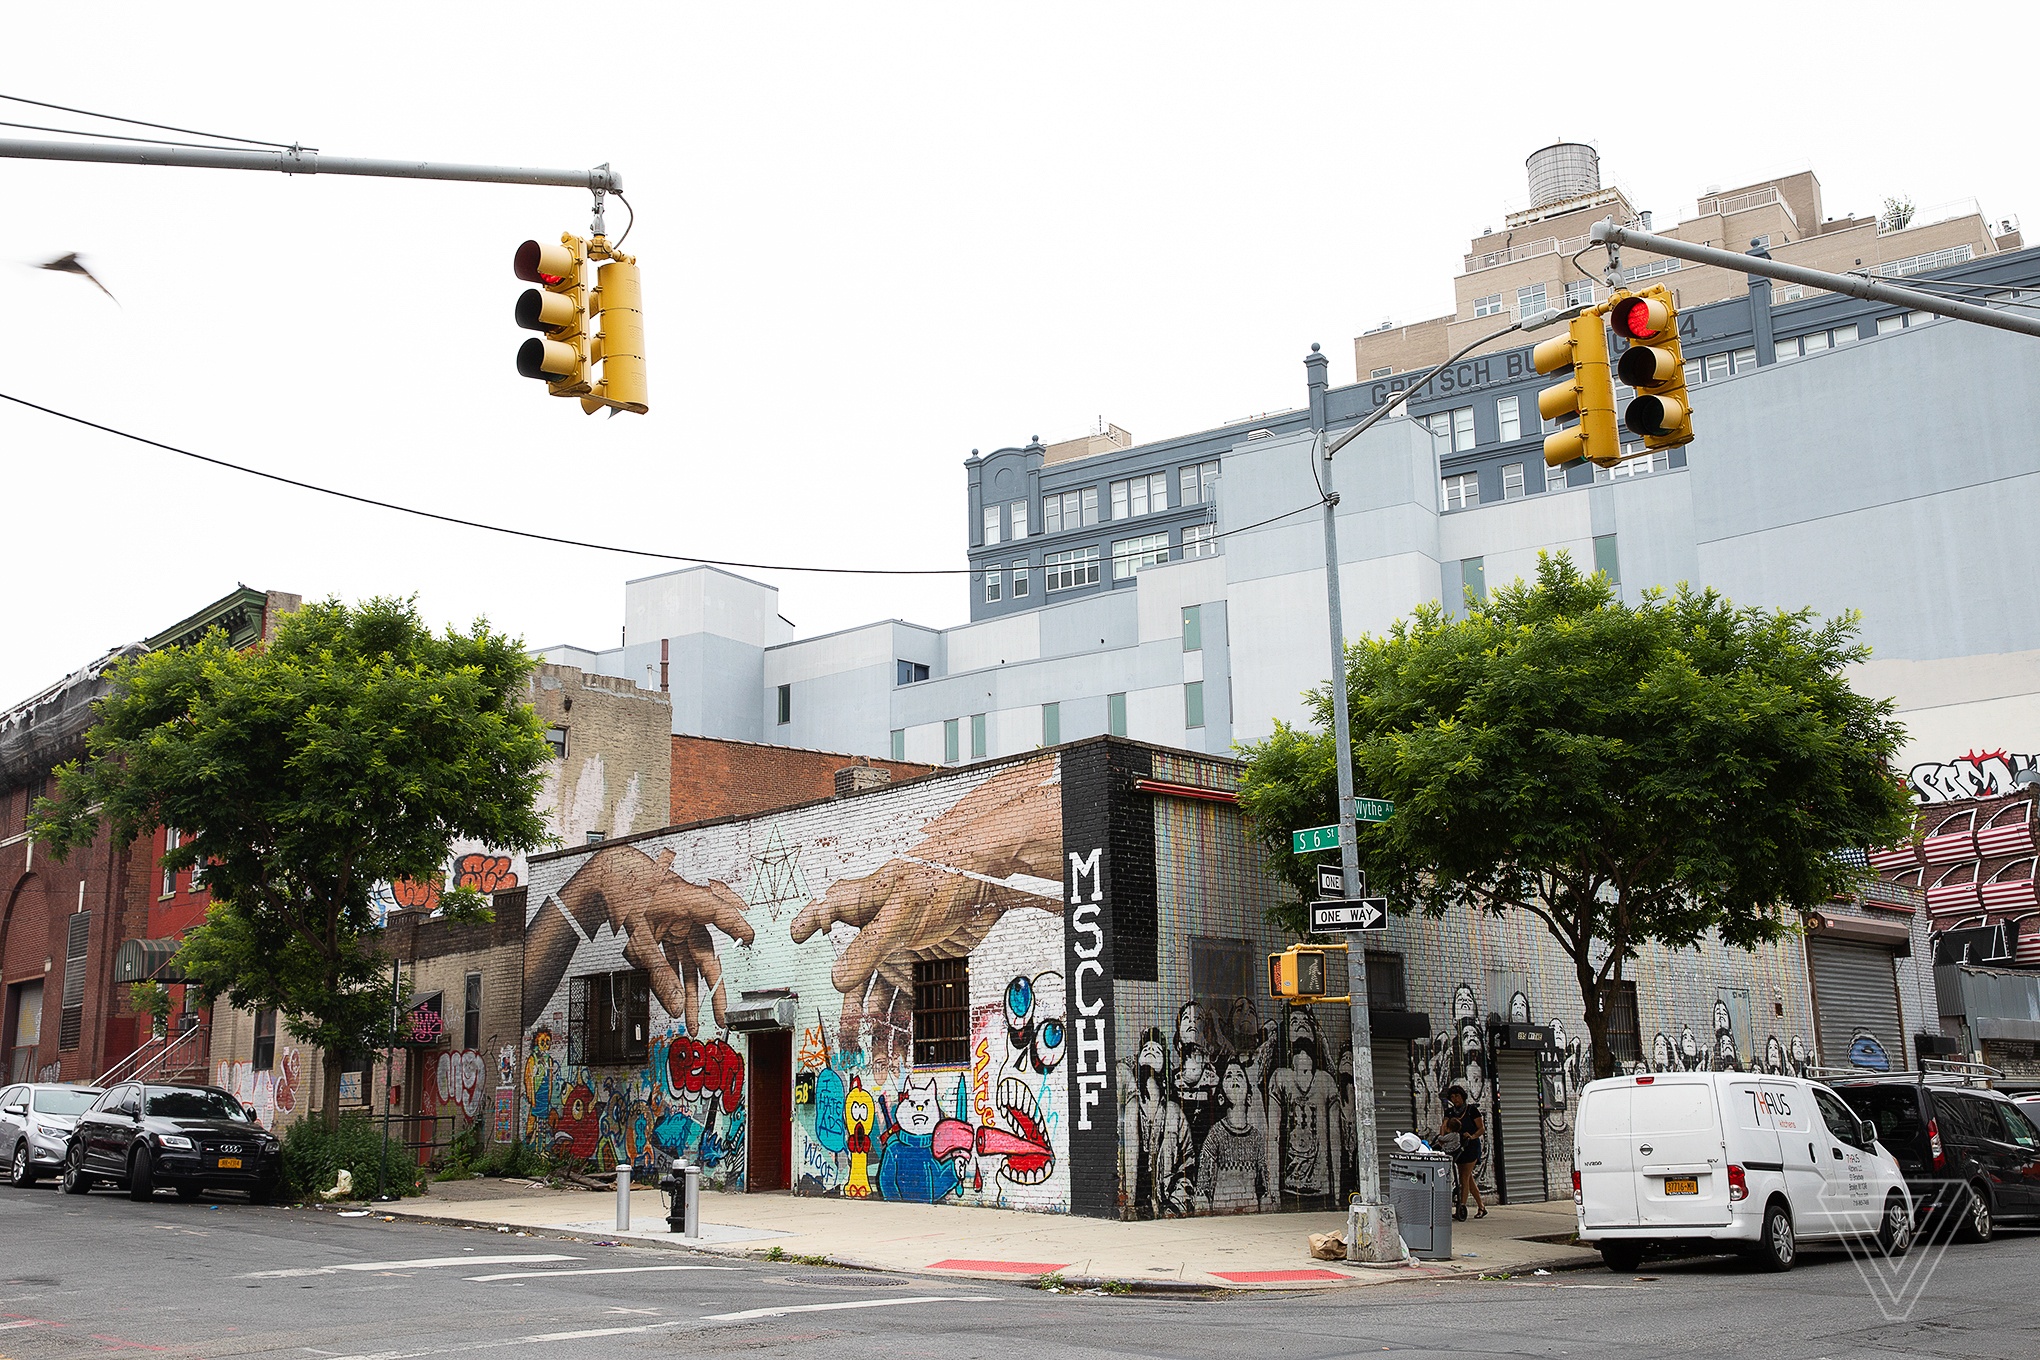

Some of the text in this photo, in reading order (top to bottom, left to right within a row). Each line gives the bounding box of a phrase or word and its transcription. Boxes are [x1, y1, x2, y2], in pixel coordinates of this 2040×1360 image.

[1355, 800, 1383, 819] Wythe
[1299, 828, 1335, 850] S 6 St
[1325, 875, 1340, 889] ONE
[1320, 908, 1374, 923] ONE WAY
[1068, 847, 1107, 1131] MSCHF
[1540, 1051, 1559, 1063] TBA
[822, 1079, 831, 1093] I
[818, 1093, 842, 1117] HATE
[1745, 1090, 1792, 1127] 7HAUS
[818, 1111, 844, 1138] ADS
[803, 1135, 834, 1182] WOOF
